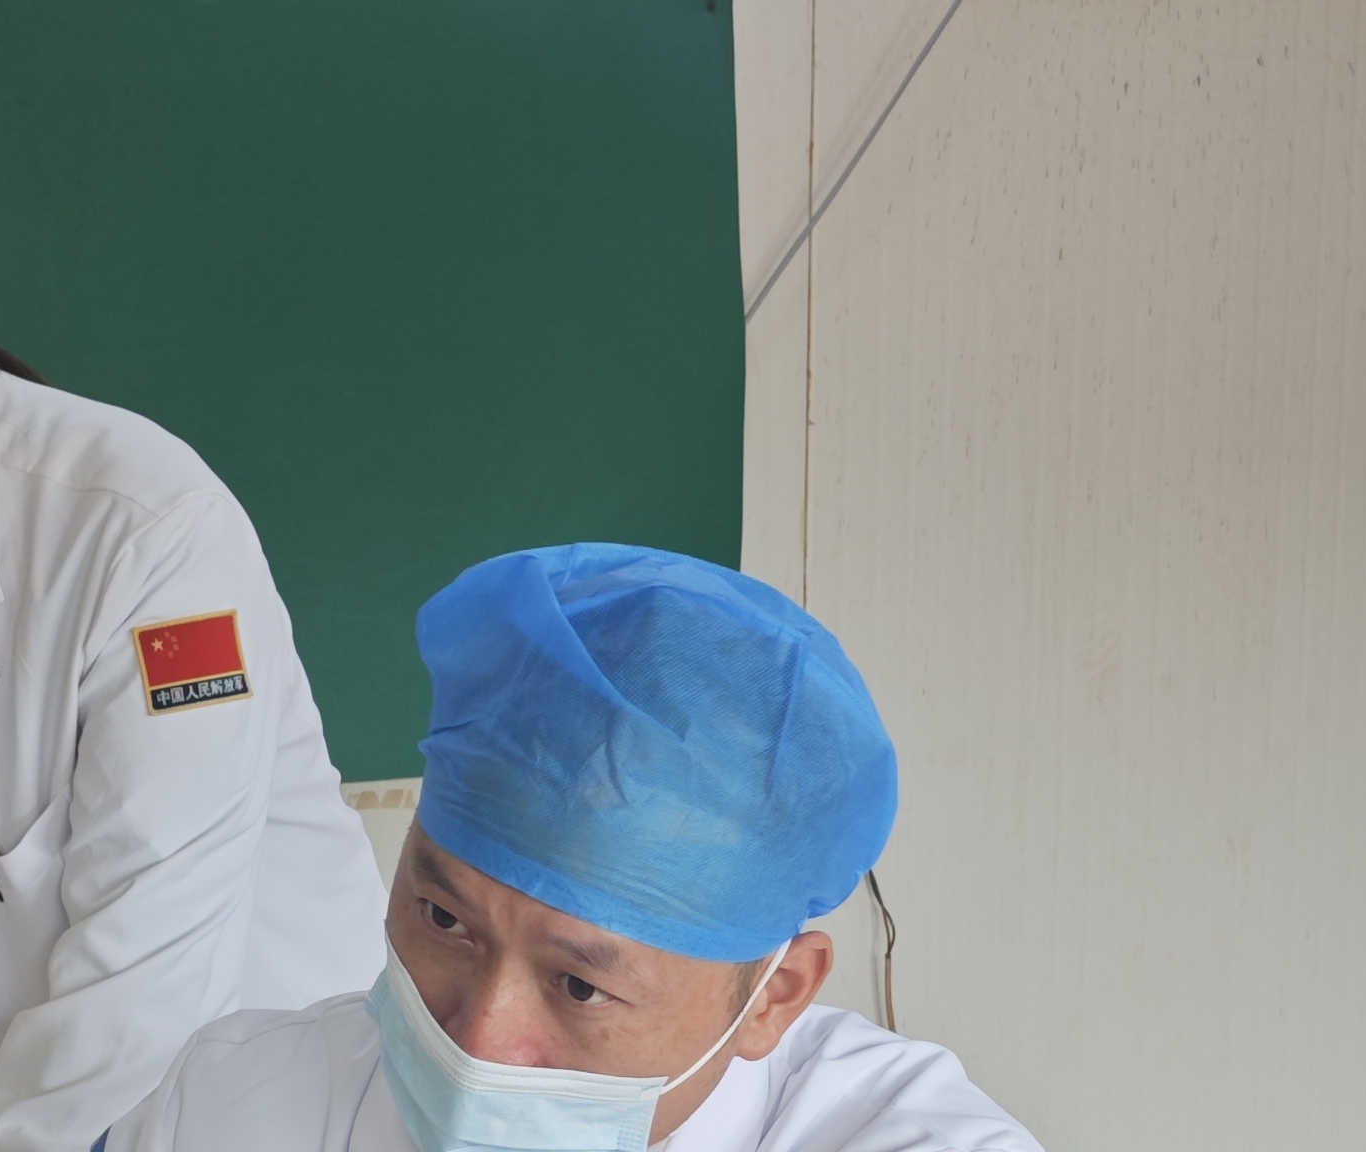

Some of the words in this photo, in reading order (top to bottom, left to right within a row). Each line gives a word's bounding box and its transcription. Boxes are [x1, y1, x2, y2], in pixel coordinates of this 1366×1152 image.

[157, 676, 243, 705] 中国人民解放军
